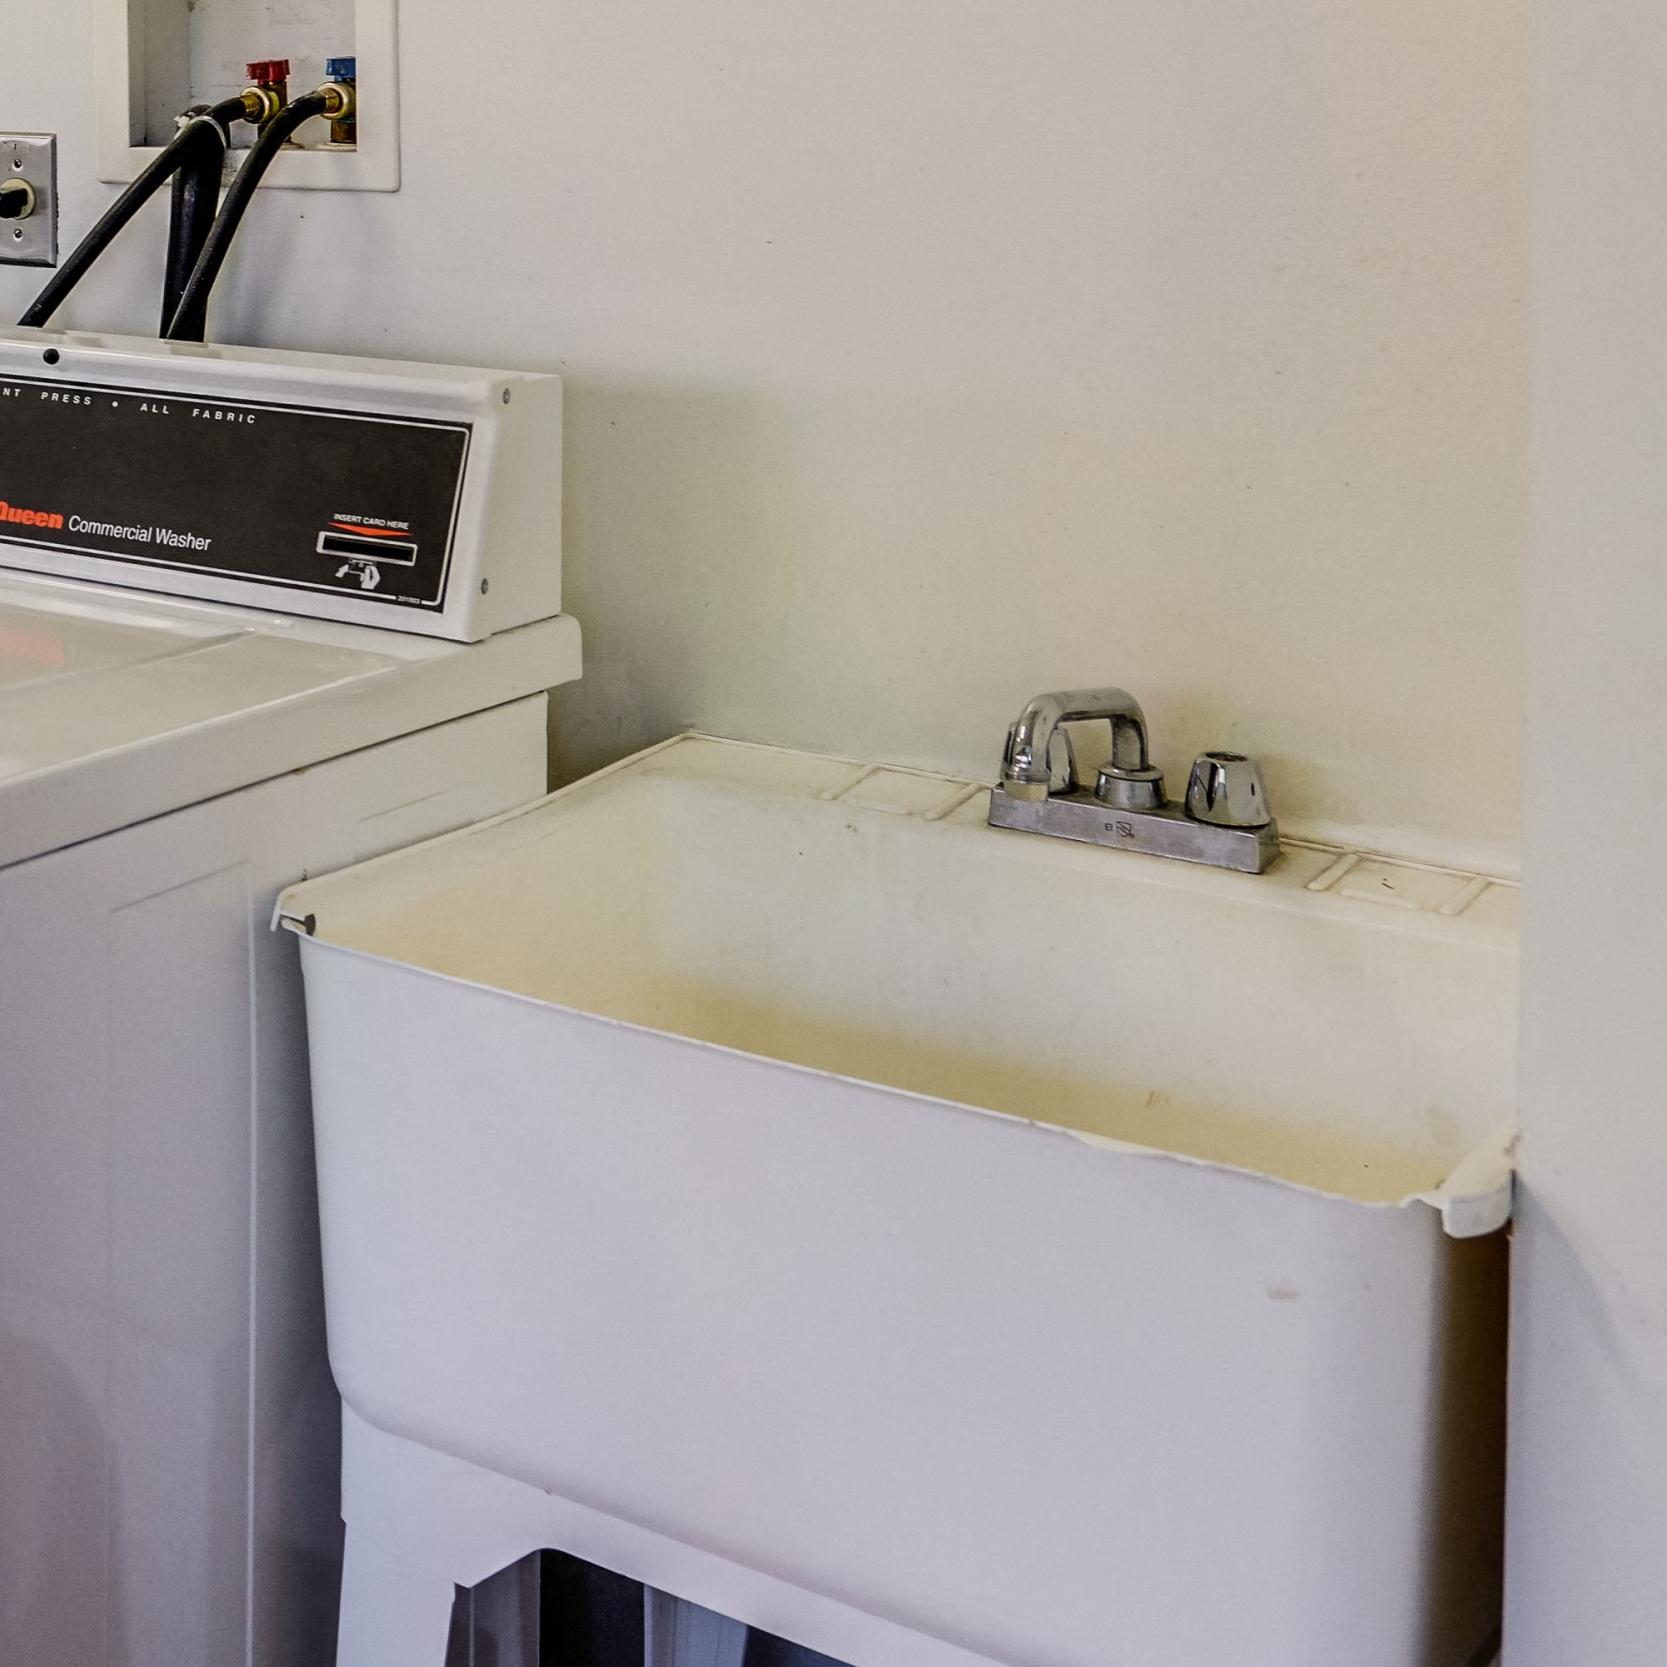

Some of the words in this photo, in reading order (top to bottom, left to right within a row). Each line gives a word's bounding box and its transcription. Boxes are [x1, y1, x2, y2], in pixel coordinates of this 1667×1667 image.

[39, 391, 92, 406] PRESS
[139, 402, 171, 414] ALL
[190, 407, 256, 424] FABRIC
[67, 512, 153, 544] Commercial
[153, 524, 212, 553] Washer
[332, 512, 363, 524] INSERT
[361, 516, 387, 527] CARD
[385, 520, 410, 530] HERE
